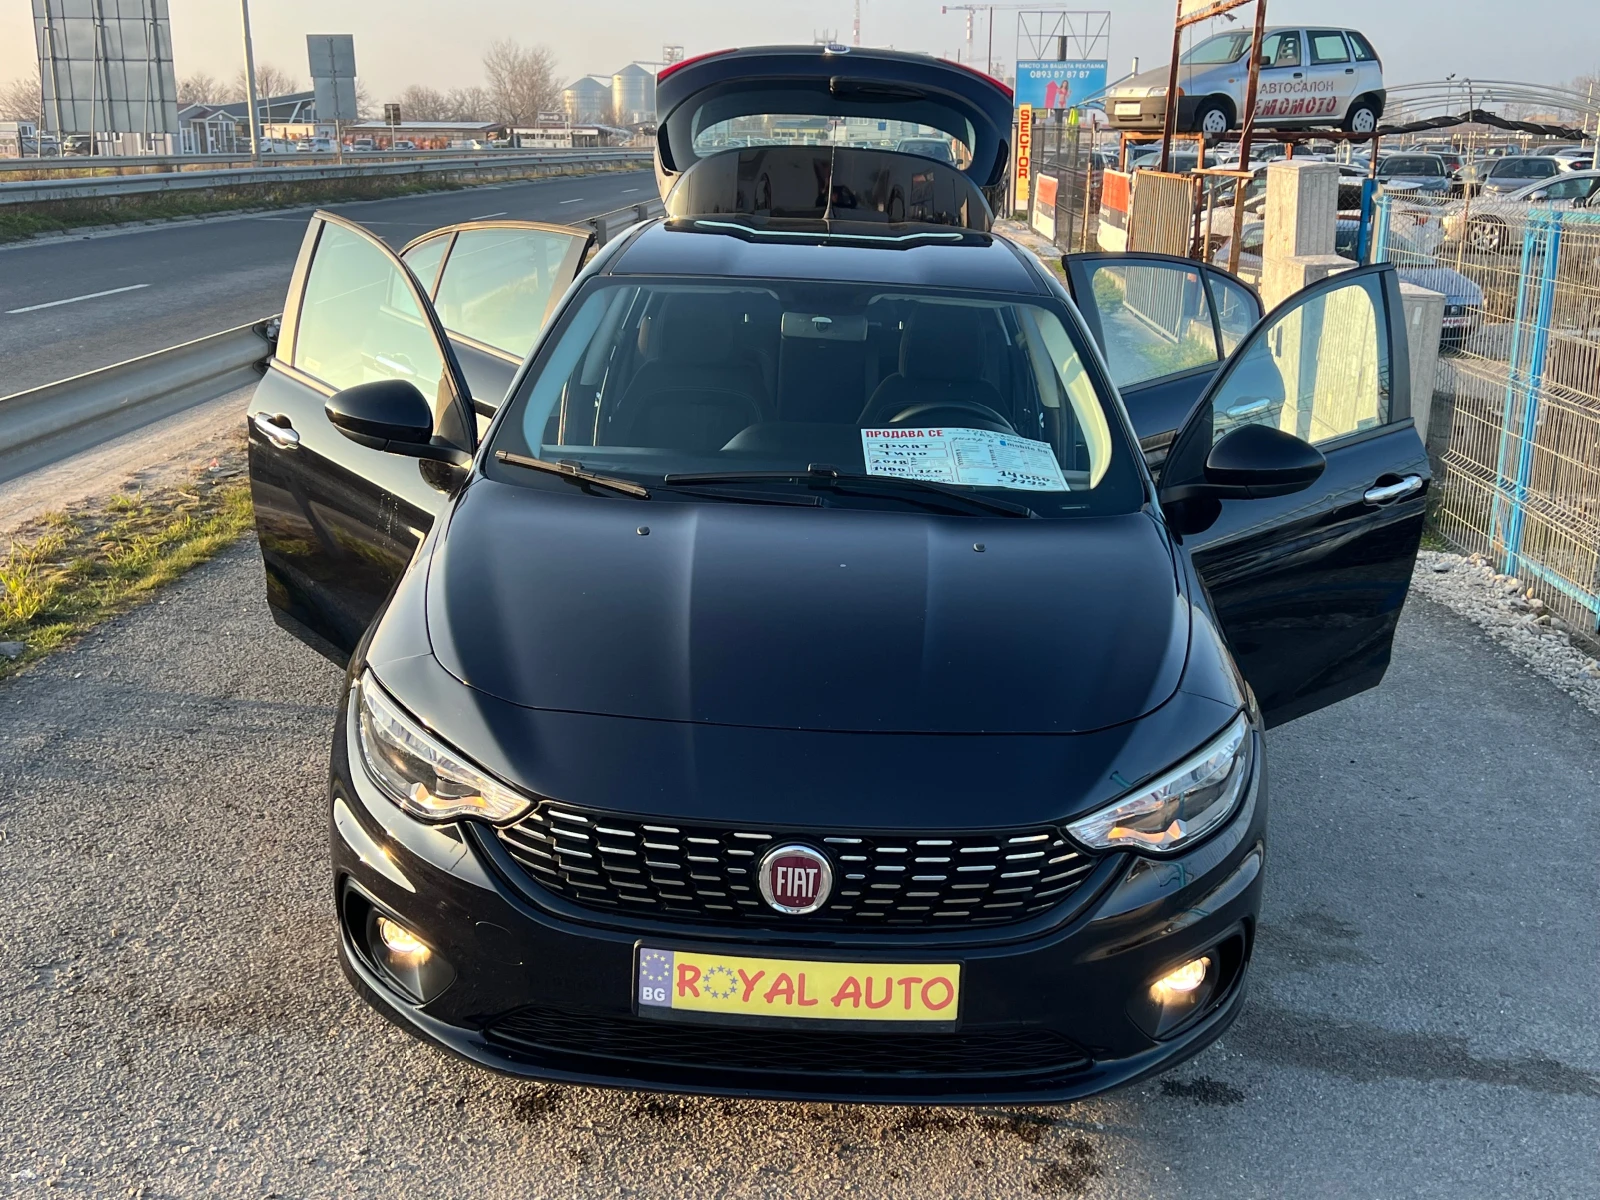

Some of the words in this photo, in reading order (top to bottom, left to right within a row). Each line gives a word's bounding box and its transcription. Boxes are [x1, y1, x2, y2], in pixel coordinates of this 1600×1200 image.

[1029, 71, 1052, 79] 0893
[1260, 81, 1334, 94] АВТОСАЛОН
[1018, 109, 1030, 179] SECTOR
[865, 430, 925, 438] ПРОДАВА
[928, 429, 944, 437] СЕ
[776, 866, 819, 898] FIAT
[642, 986, 666, 1001] BG
[830, 975, 955, 1012] AUTO
